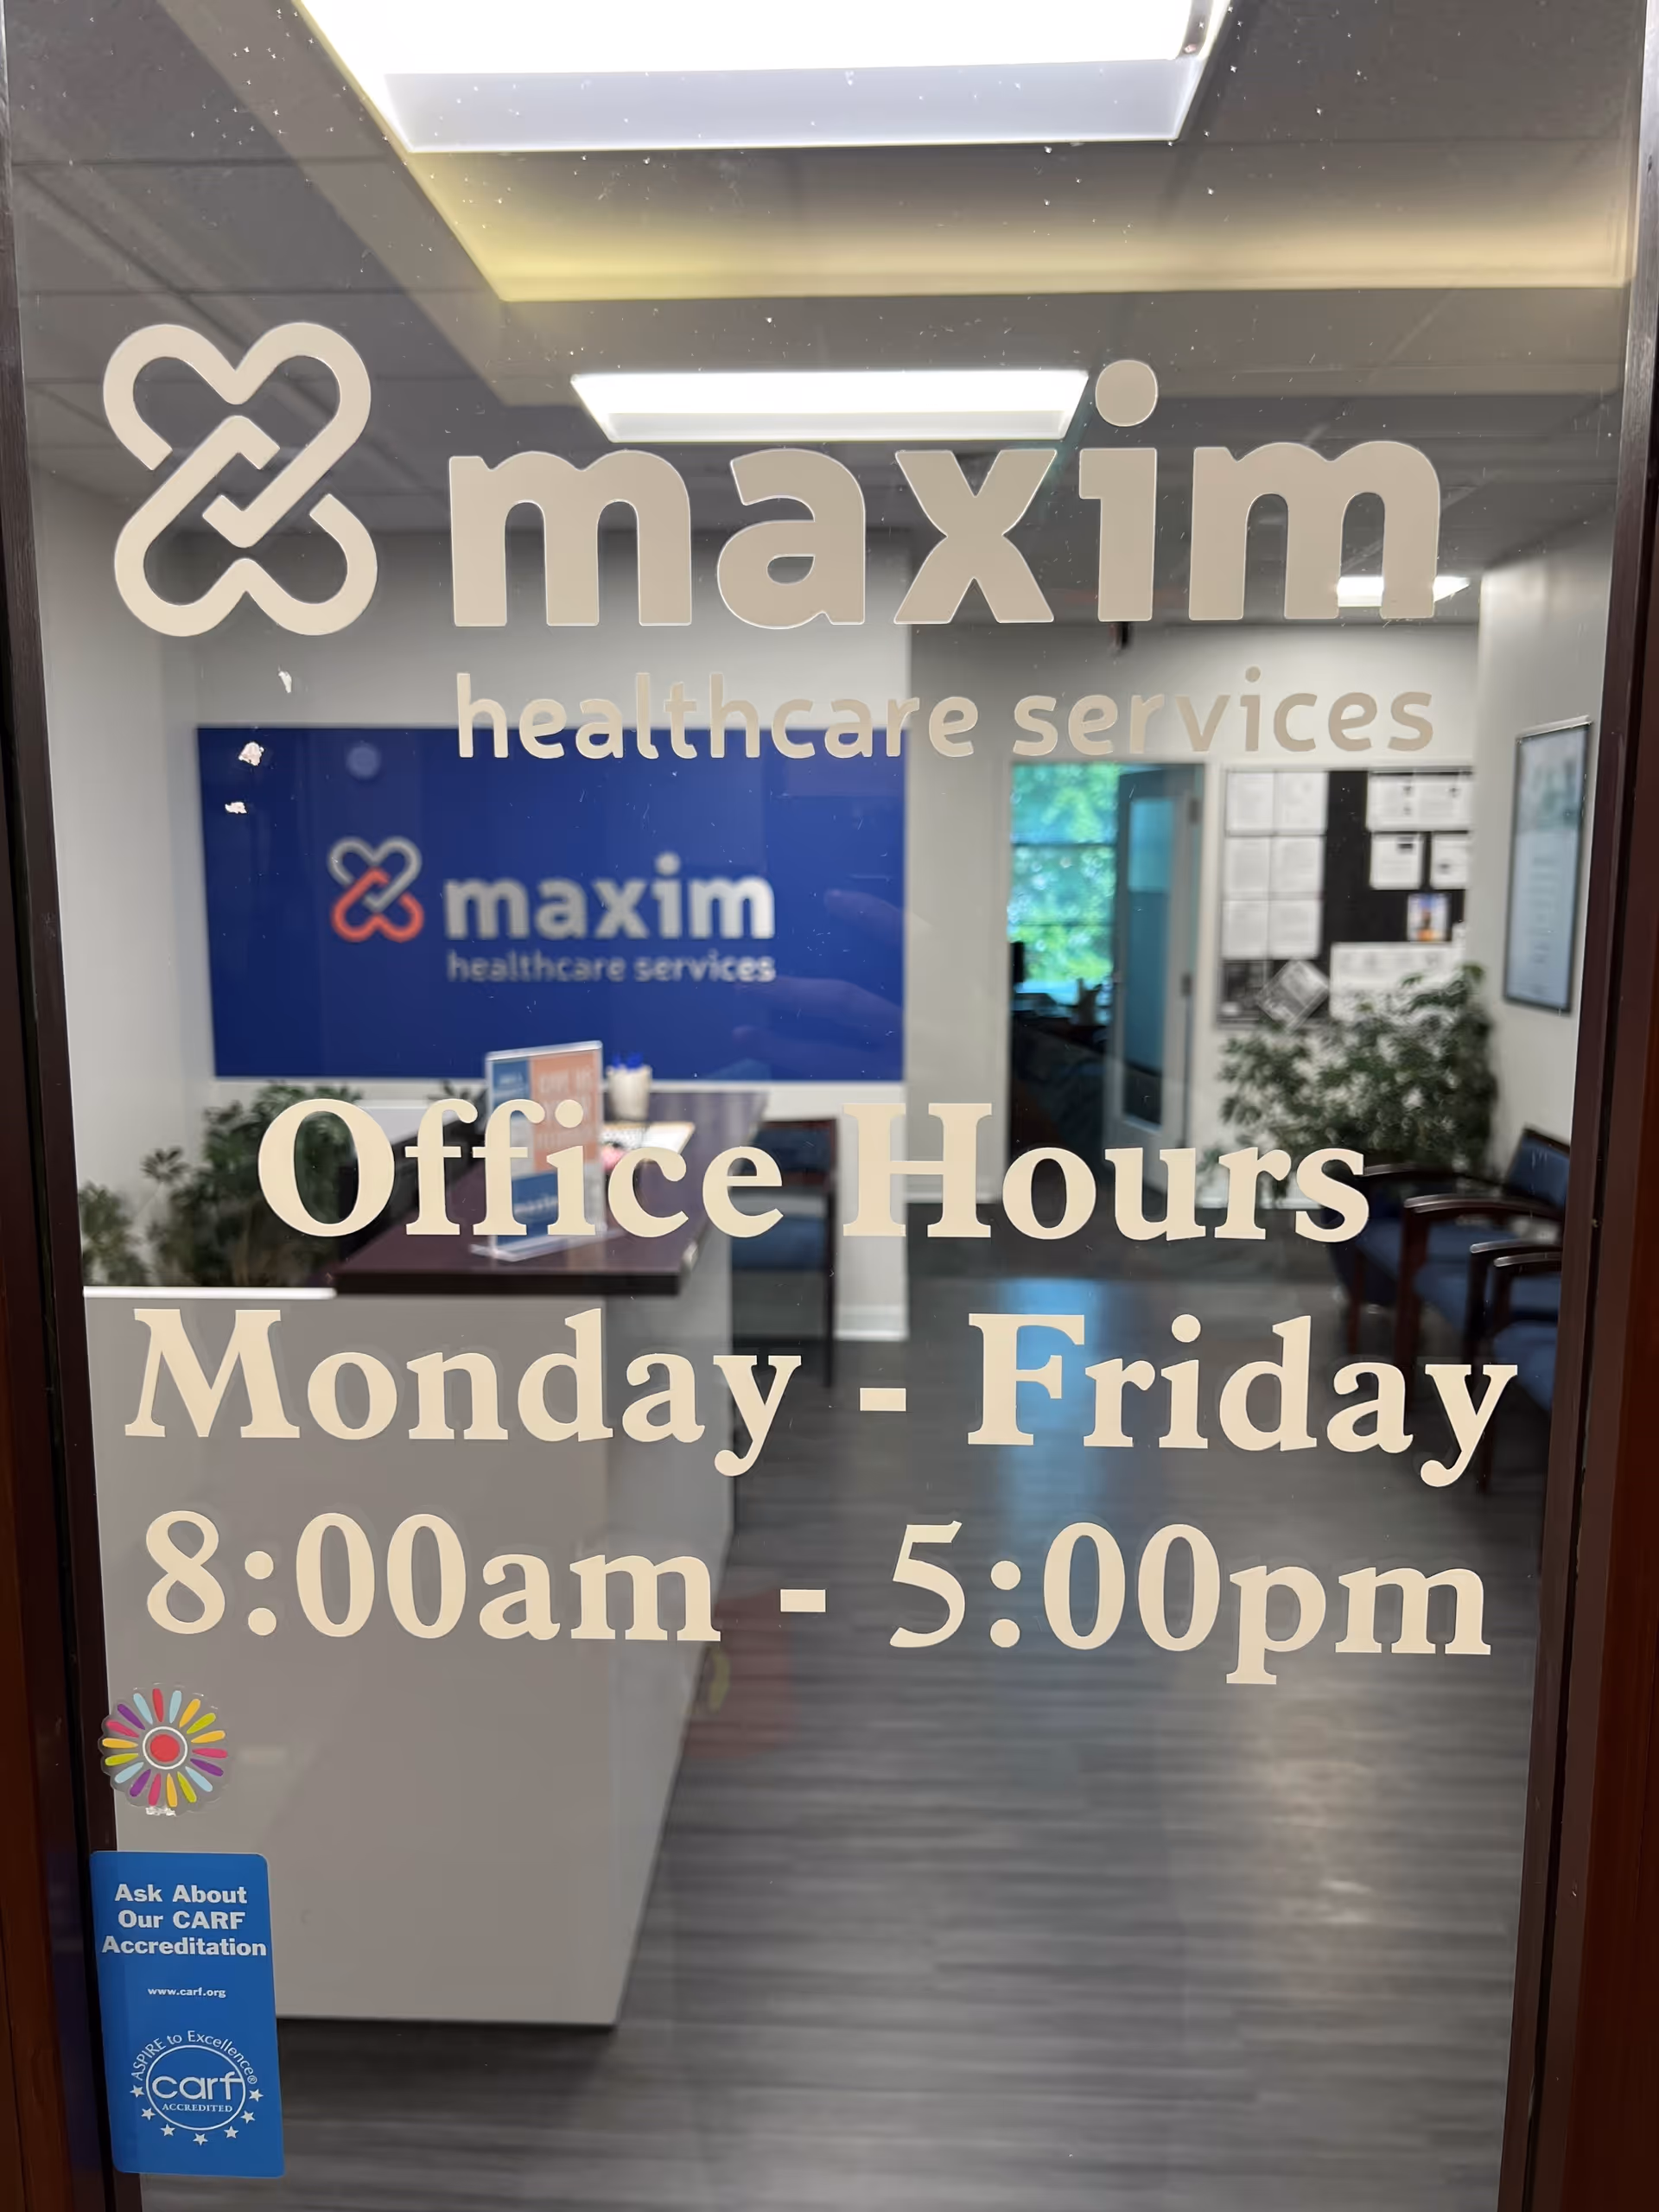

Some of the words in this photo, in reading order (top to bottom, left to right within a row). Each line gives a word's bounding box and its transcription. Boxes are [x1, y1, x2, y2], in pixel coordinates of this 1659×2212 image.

[449, 359, 1440, 629] maxim
[456, 672, 979, 760] healthcare
[1012, 665, 1434, 757] services
[443, 850, 777, 941] maxim
[447, 950, 626, 983] healthcare
[634, 949, 777, 983] services
[257, 1098, 784, 1238] Office
[842, 1103, 1370, 1243] Hours
[124, 1308, 802, 1478] Monday
[860, 1388, 906, 1412] -
[968, 1313, 1518, 1487] Friday
[146, 1510, 721, 1643] 8:00am
[780, 1588, 826, 1613] -
[890, 1520, 1491, 1685] 5:00pm
[115, 1884, 162, 1903] Ask
[173, 1885, 247, 1904] About
[118, 1910, 163, 1929] Our
[173, 1910, 246, 1929] CARF
[102, 1936, 267, 1956] Accreditation
[148, 1987, 226, 1999] www.carf.org
[131, 2037, 166, 2081] ASPIRE
[167, 2035, 182, 2044] to
[152, 2071, 243, 2100] carf
[162, 2103, 232, 2113] ACCREDITED
